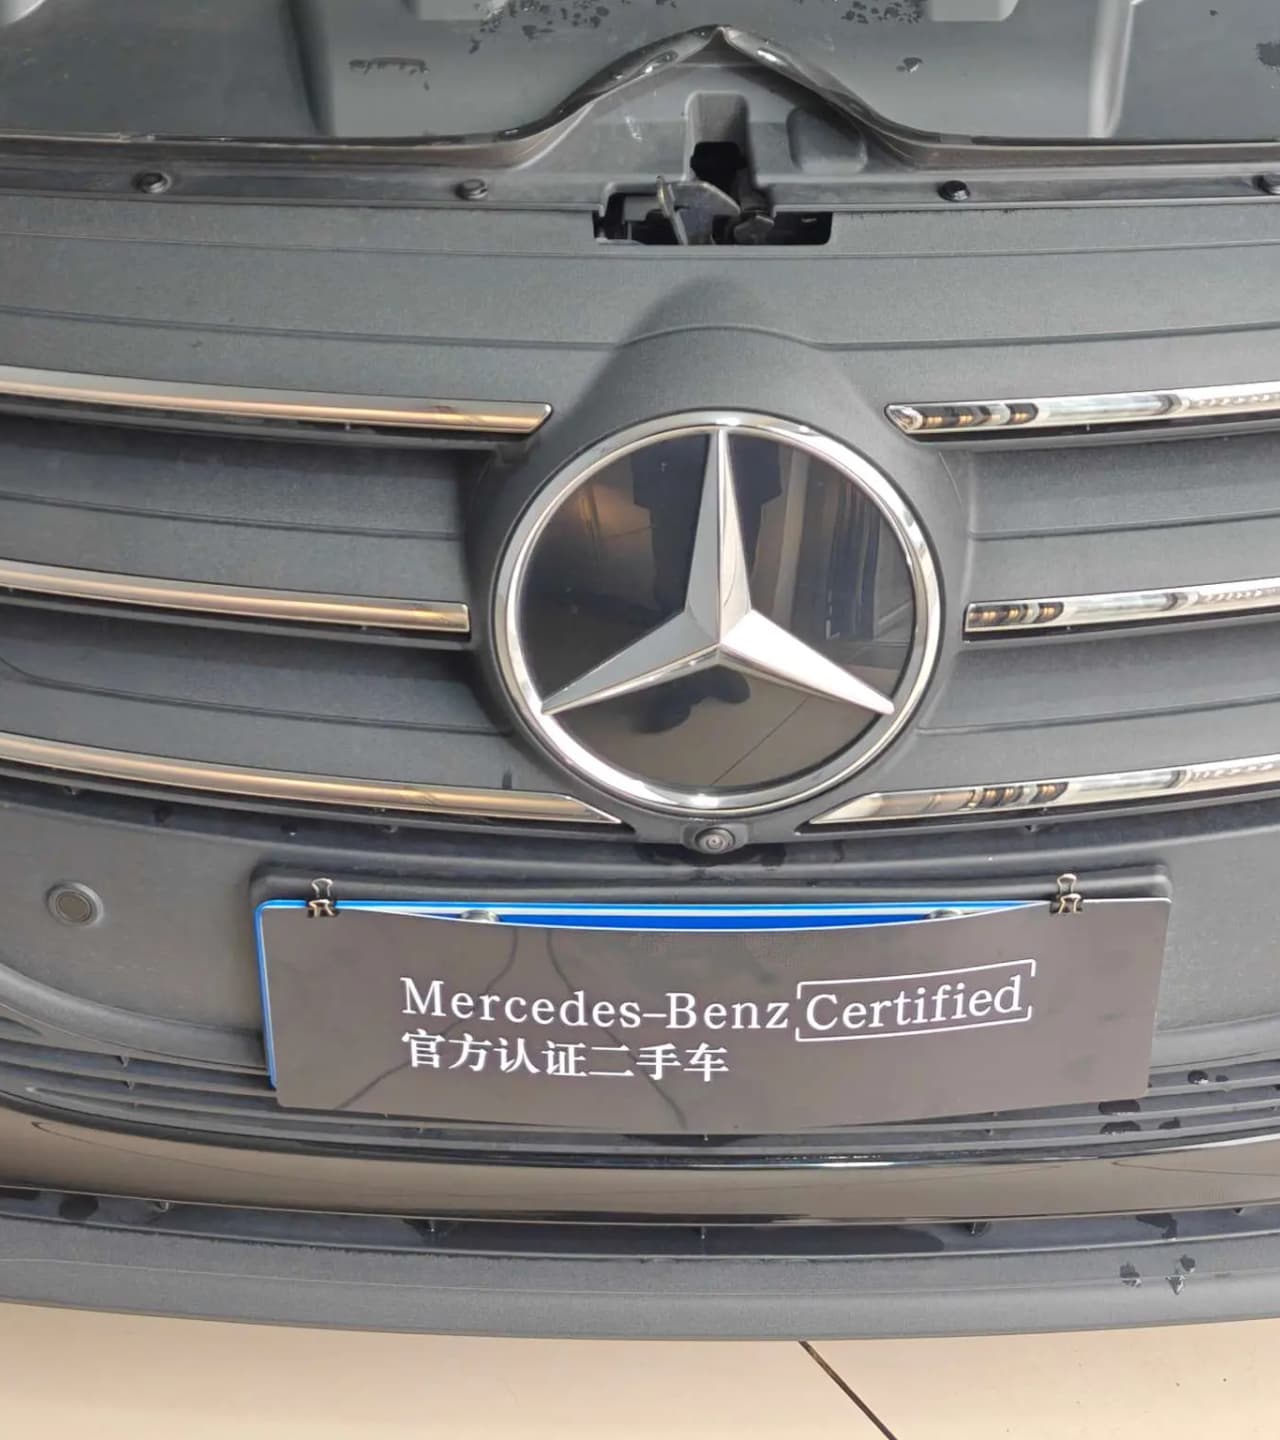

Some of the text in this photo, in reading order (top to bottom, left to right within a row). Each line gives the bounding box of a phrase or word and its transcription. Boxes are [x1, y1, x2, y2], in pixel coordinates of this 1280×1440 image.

[401, 974, 1023, 1031] Mercedes-Benz Certified
[401, 1028, 730, 1082] 官方认证二手车
